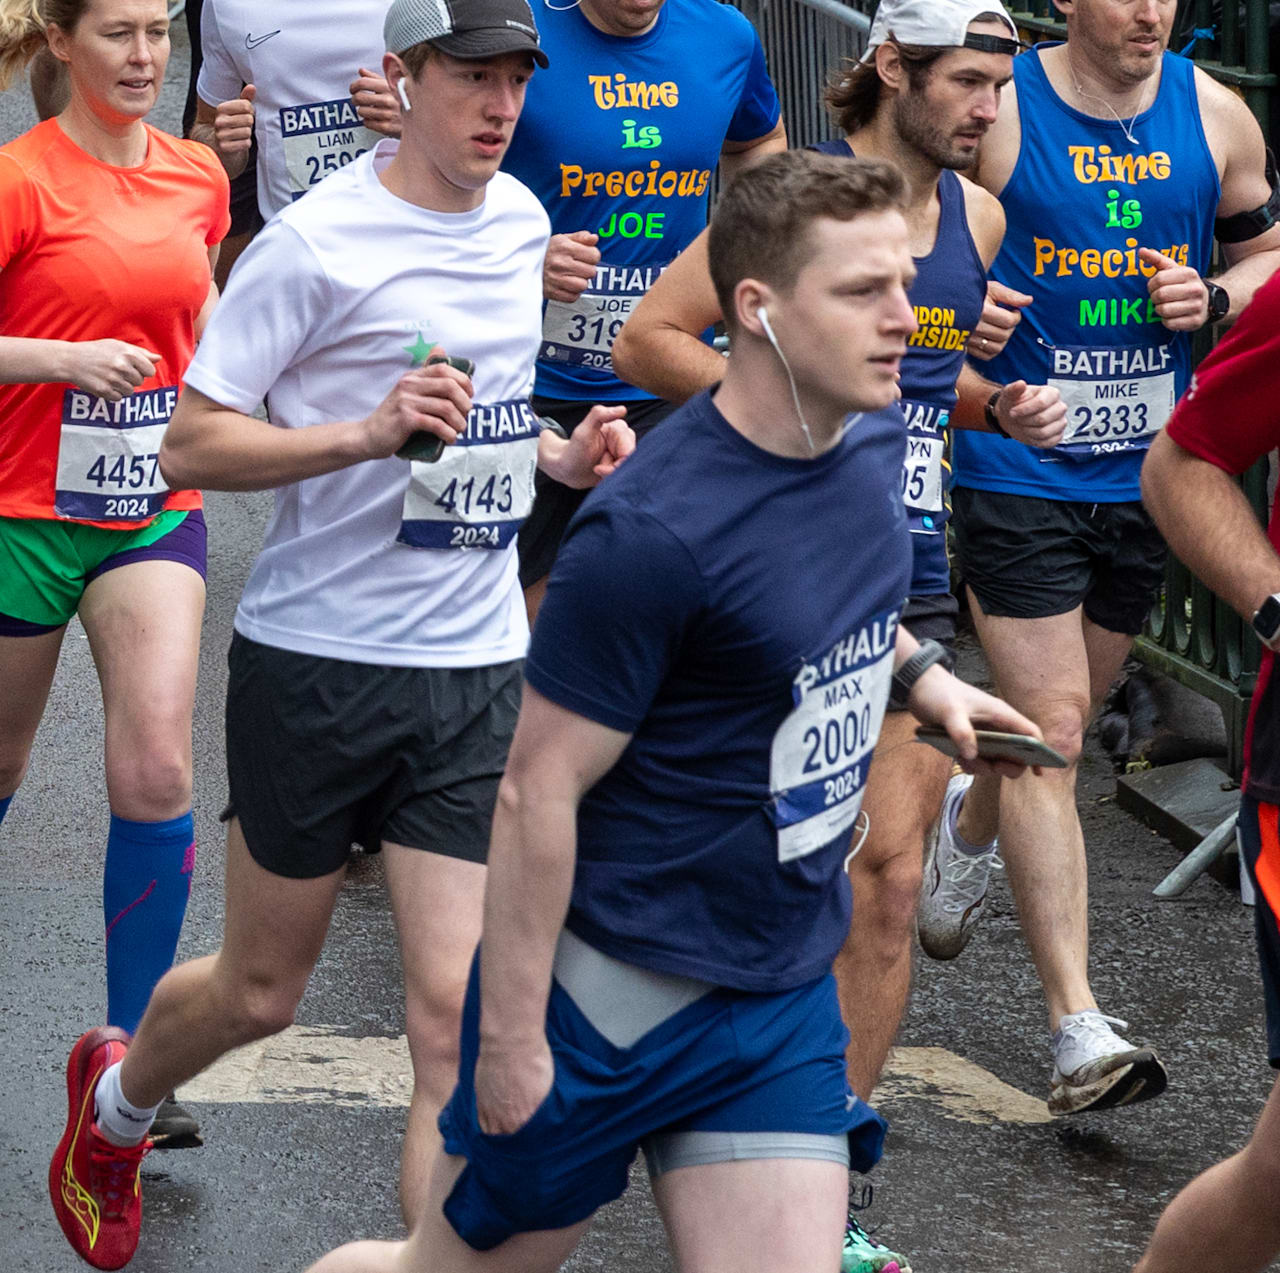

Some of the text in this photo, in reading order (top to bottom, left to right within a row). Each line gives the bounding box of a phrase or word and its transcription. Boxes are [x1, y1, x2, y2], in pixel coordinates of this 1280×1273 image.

[588, 73, 679, 110] Time
[283, 103, 364, 133] BATHA
[621, 119, 662, 149] is
[317, 131, 355, 149] LIAM
[306, 148, 368, 185] 25
[559, 160, 711, 197] Precious
[1068, 145, 1171, 184] Time
[598, 211, 666, 239] JOE
[1104, 189, 1143, 229] is
[596, 299, 632, 313] JOE
[1080, 298, 1165, 326] MIKE
[907, 327, 970, 351] HSIDE
[582, 352, 614, 368] 202
[1054, 345, 1172, 375] BATHALF
[1094, 382, 1139, 399] MIKE
[70, 391, 176, 423] BATHALF
[458, 404, 533, 440] THALF
[1074, 402, 1148, 438] 2333
[86, 453, 160, 489] 4457
[105, 498, 149, 516] 2024
[435, 474, 513, 515] 4143
[450, 525, 500, 546] 2024
[824, 676, 863, 709] MAX
[802, 702, 871, 775] 2000
[824, 765, 861, 806] 2024
